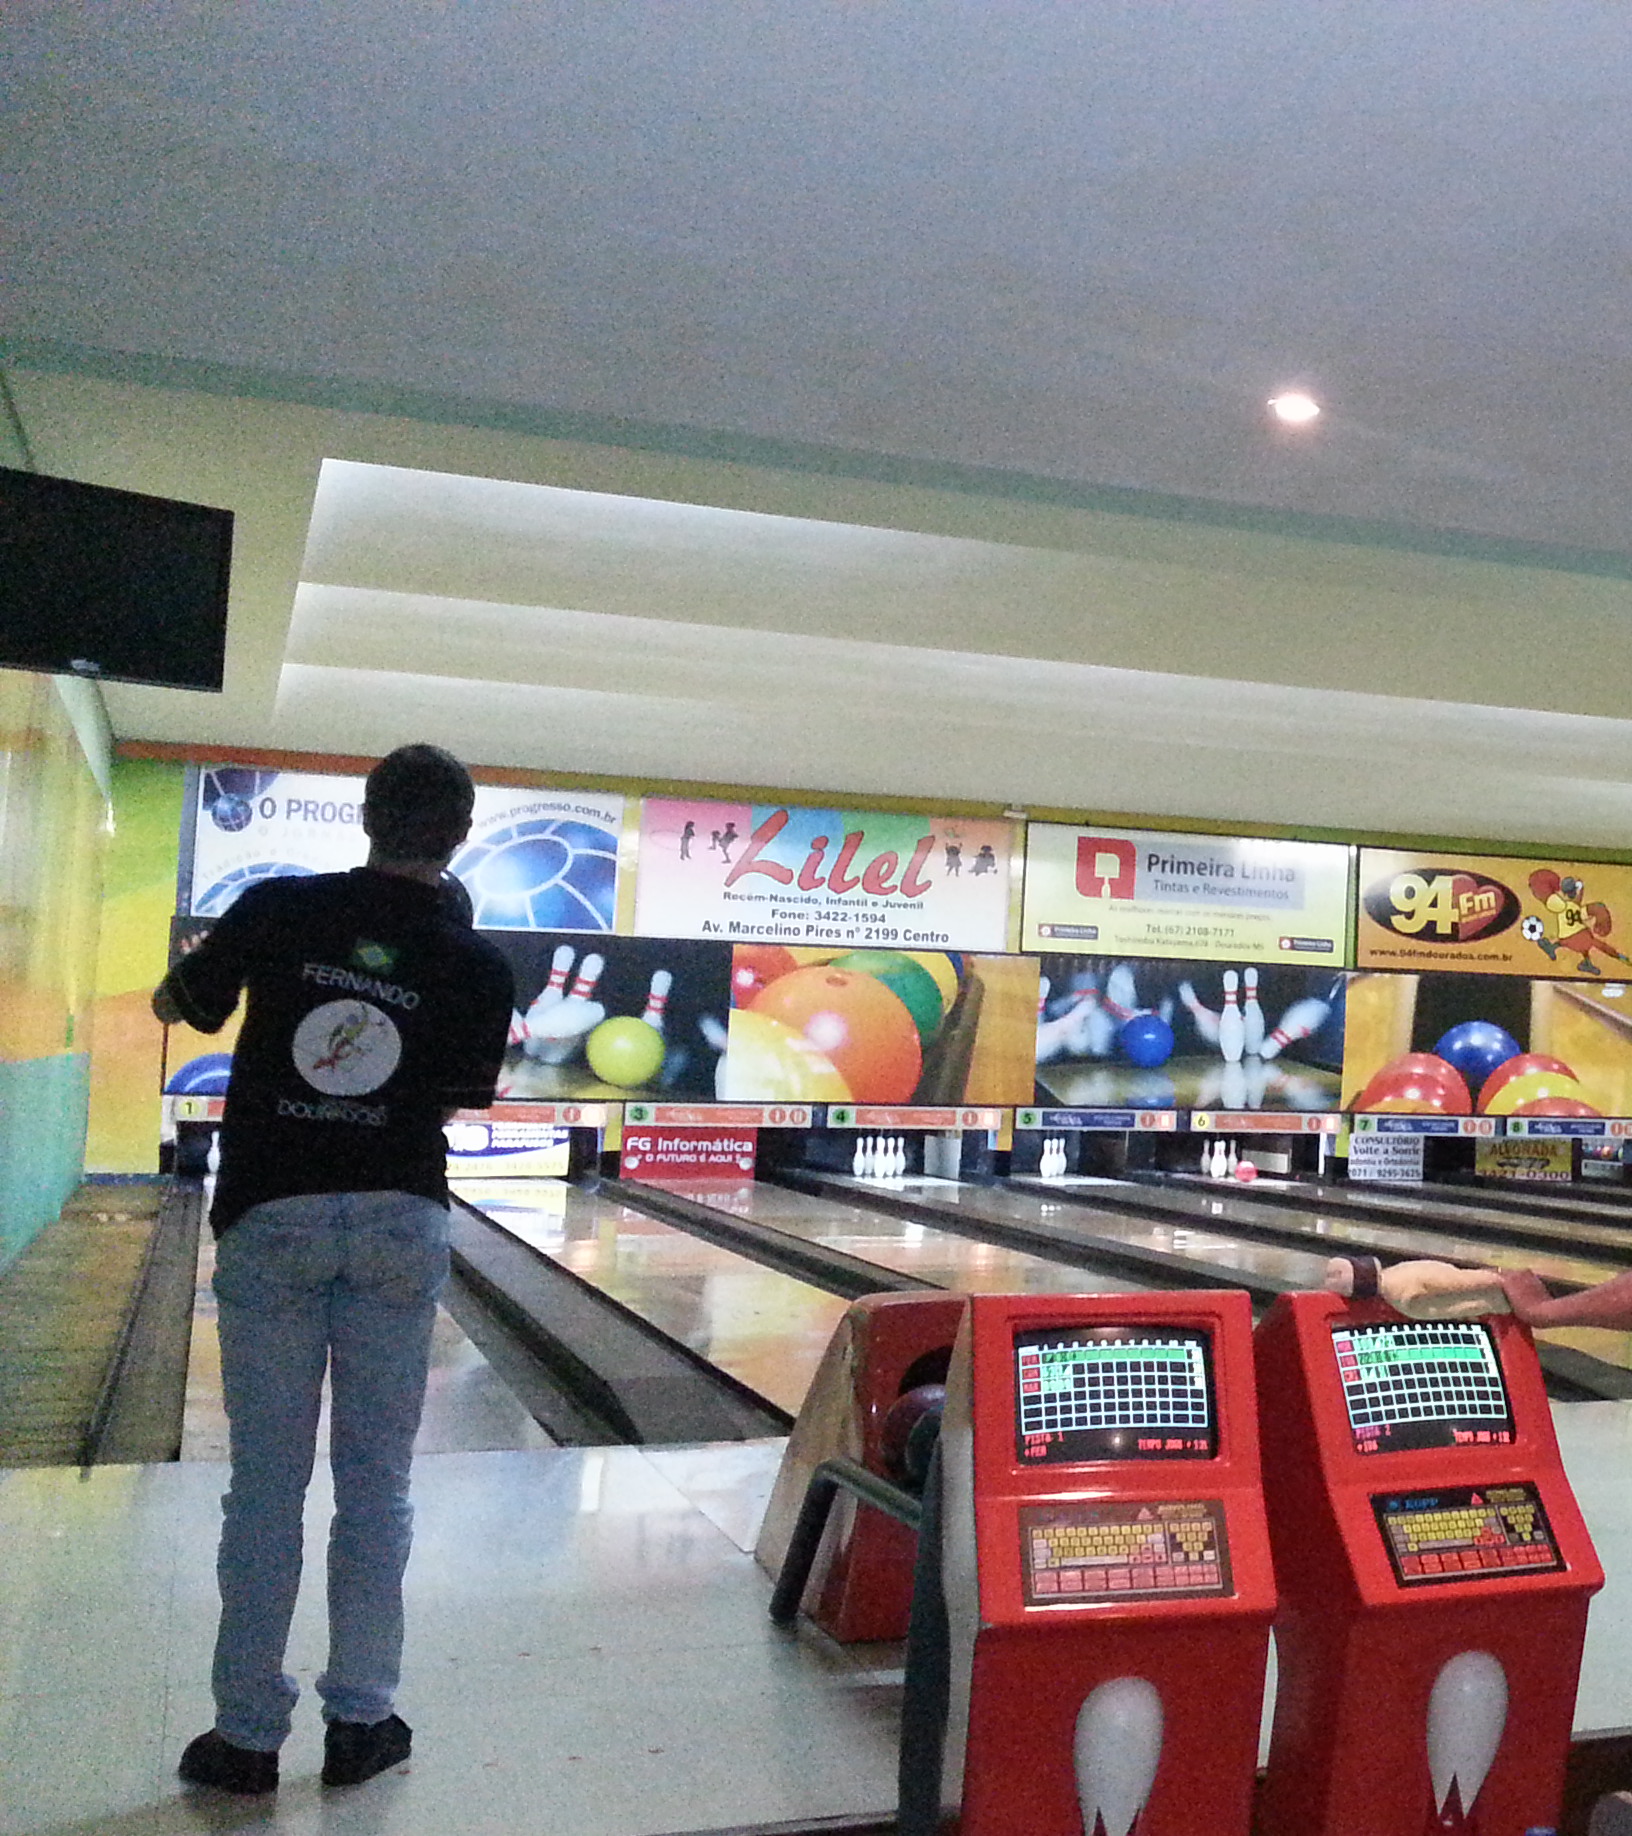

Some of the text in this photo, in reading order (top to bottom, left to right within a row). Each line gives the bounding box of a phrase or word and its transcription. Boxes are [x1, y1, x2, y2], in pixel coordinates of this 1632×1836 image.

[259, 797, 277, 819] O
[477, 801, 617, 828] www.progresso.com.br
[724, 810, 936, 898] Lilel
[1147, 853, 1296, 882] Primeira Linha
[1153, 879, 1289, 901] Tintas e Revestimentos
[826, 896, 869, 908] Infantil
[882, 899, 924, 910] Juvenil
[1389, 874, 1460, 935] 94
[771, 909, 887, 924] Fone: 3422-1594
[702, 921, 724, 934] Av.
[729, 921, 801, 938] Marcelino
[805, 924, 842, 939] Pires
[864, 927, 899, 941] 2199
[903, 928, 949, 943] Centro
[303, 962, 421, 1010] FERNANDO
[626, 1136, 754, 1153] FG Informática
[656, 1153, 697, 1163] FUTURO
[709, 1153, 733, 1163] AQUI
